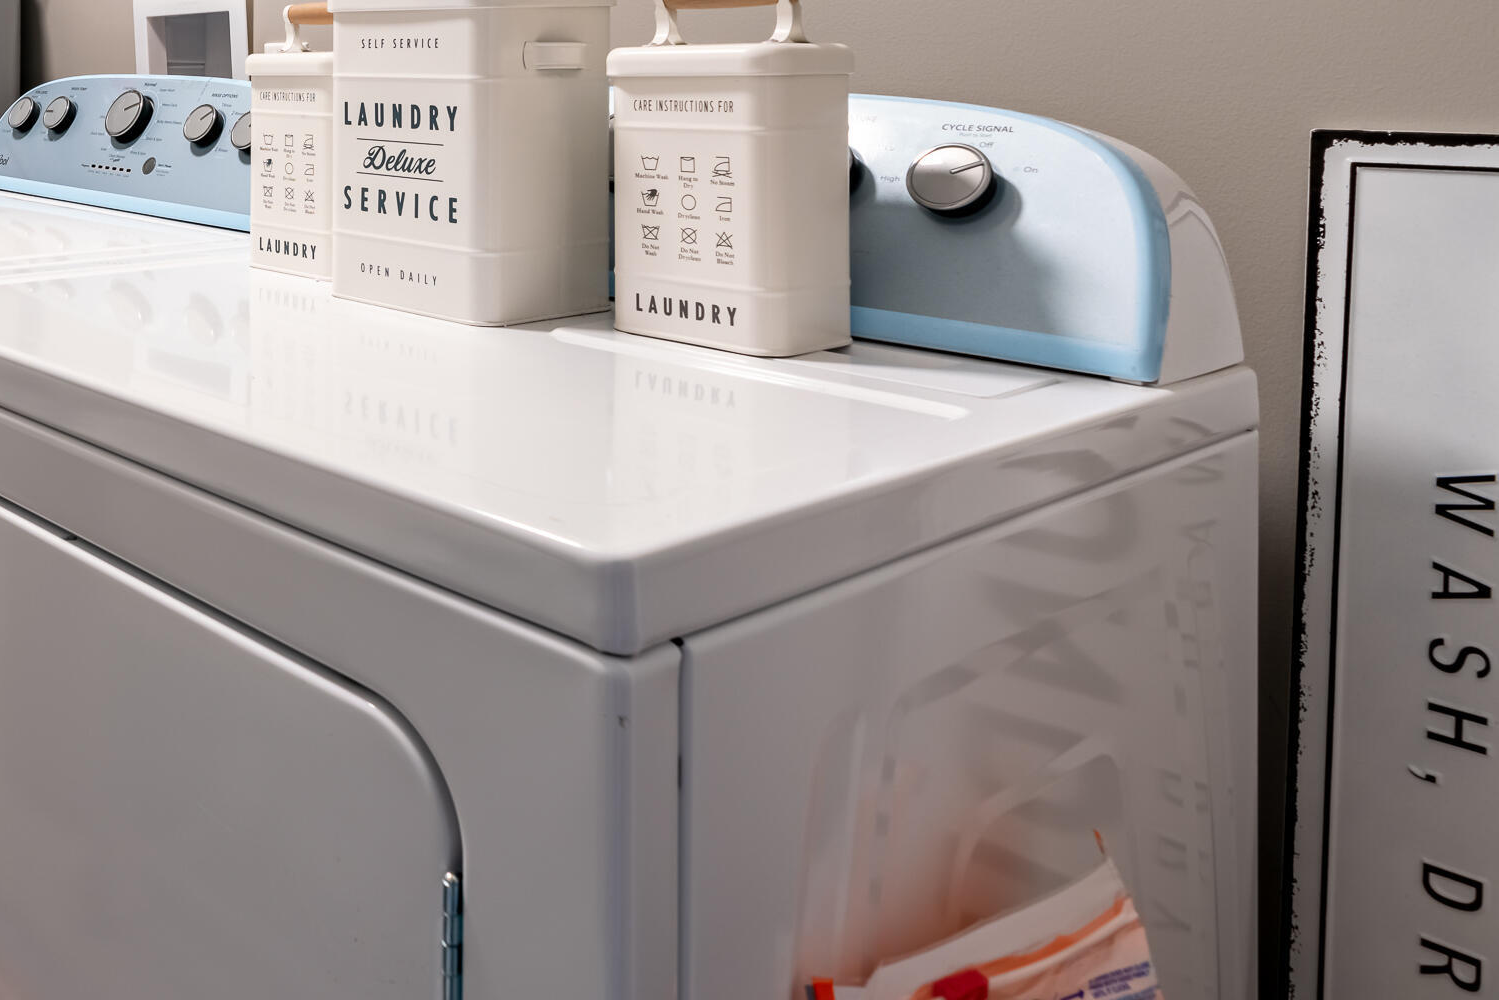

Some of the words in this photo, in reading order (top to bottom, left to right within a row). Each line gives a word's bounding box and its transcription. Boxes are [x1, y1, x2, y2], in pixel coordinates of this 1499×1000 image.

[361, 38, 385, 49] SELF
[393, 38, 439, 49] SERVICE
[260, 91, 271, 101] CARE
[271, 91, 305, 102] INSTRUCTIONS
[306, 92, 316, 102] FOR
[633, 99, 652, 112] CARE
[655, 99, 714, 113] INSTRUCTIONS
[718, 100, 734, 113] FOR
[344, 101, 458, 131] LAUNDRY
[941, 123, 974, 132] CYCLE
[976, 124, 1014, 133] SIGNAL
[363, 145, 436, 175] Deluxe
[344, 185, 458, 224] SERVICE
[259, 236, 317, 260] LAUNDRY
[360, 262, 390, 278] OPEN
[400, 269, 437, 286] DAILY
[635, 292, 737, 327] LAUNDRY
[1408, 473, 1496, 785] WASH,
[1418, 858, 1485, 993] DR
